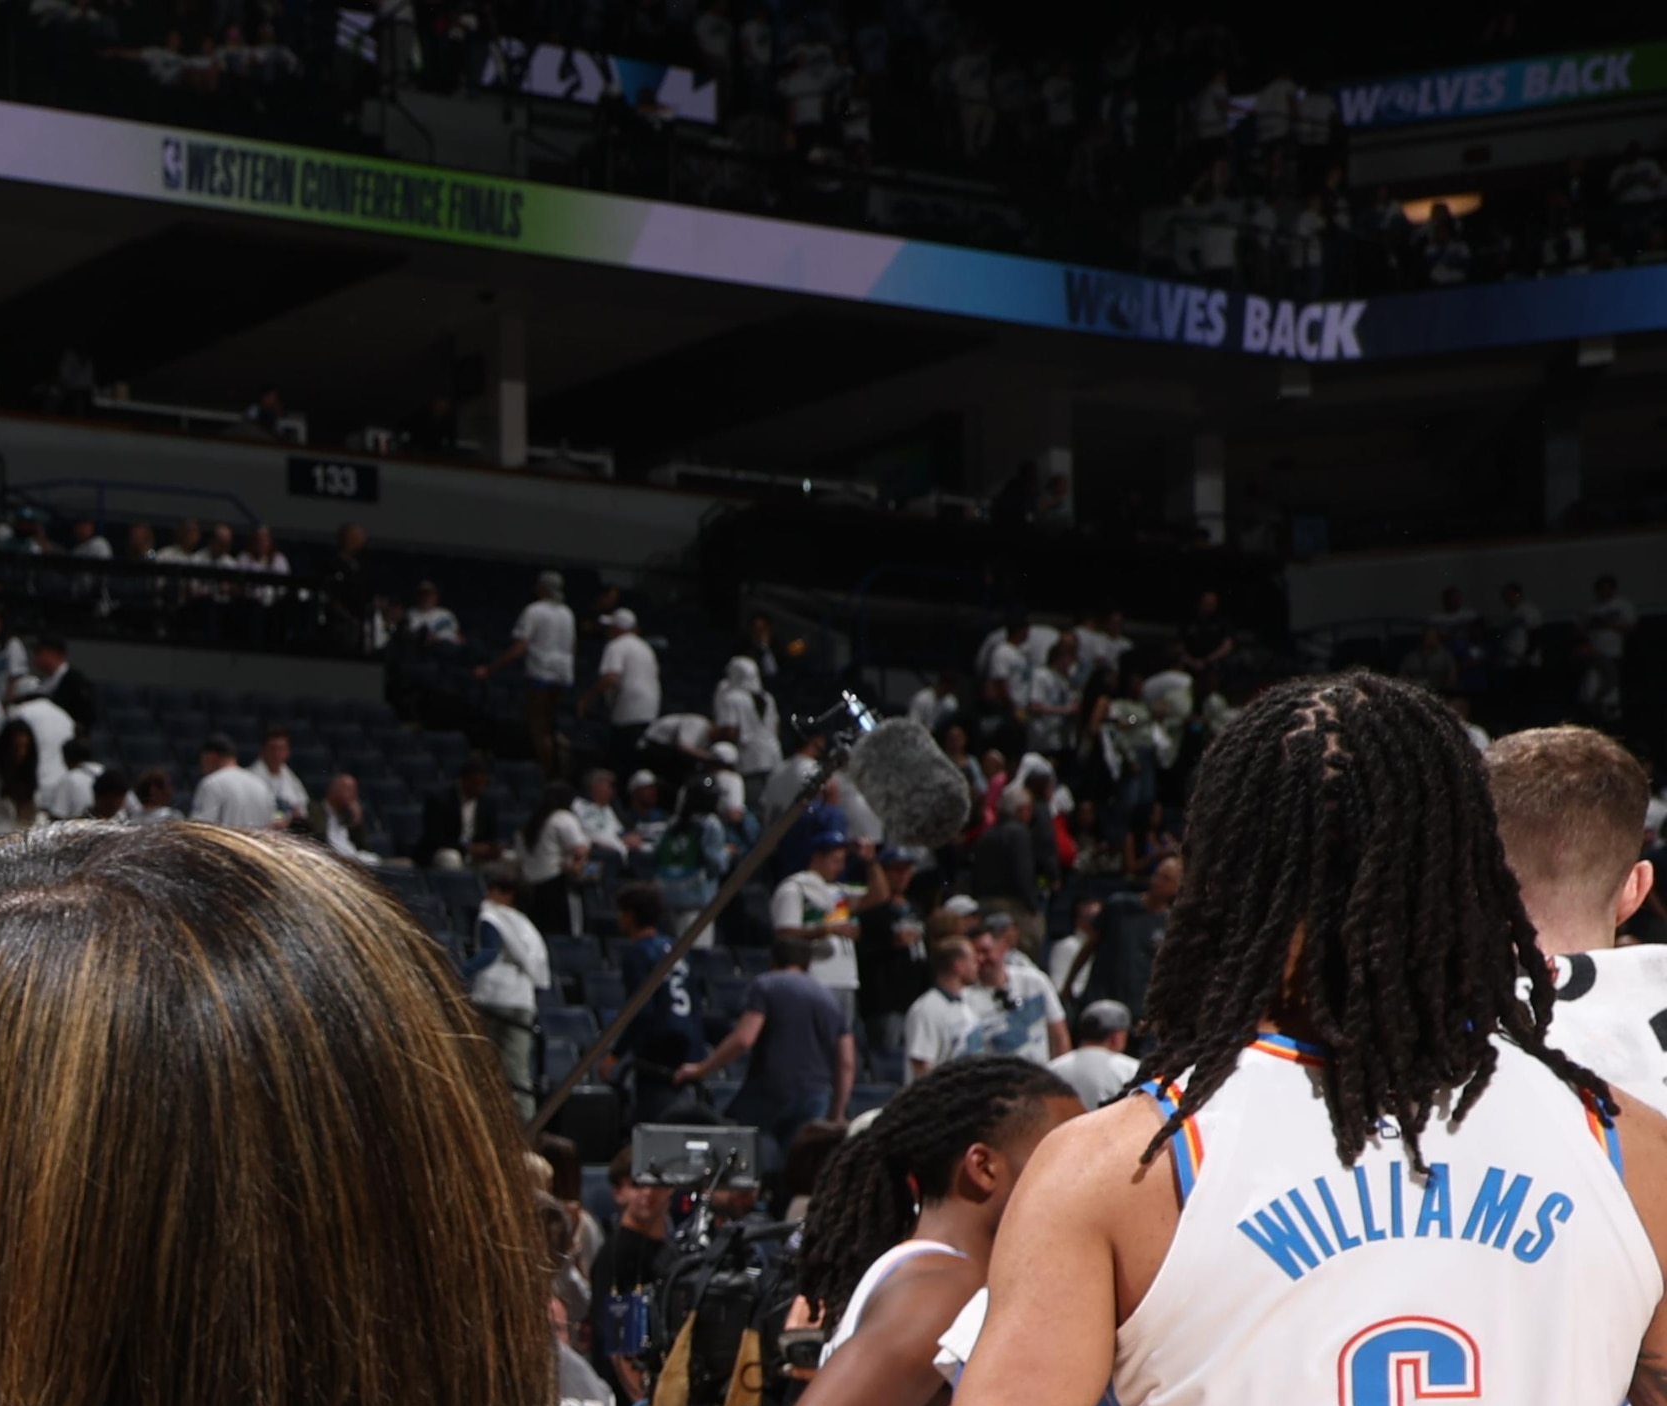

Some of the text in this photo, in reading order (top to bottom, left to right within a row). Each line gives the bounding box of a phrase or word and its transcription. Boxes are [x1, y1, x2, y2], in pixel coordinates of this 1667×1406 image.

[1522, 51, 1634, 100] BACK
[186, 142, 524, 240] WESTERN CONFERENCE FINALS
[1242, 293, 1369, 362] BACK
[312, 463, 359, 497] 133
[1236, 1160, 1575, 1282] WILLIAMS
